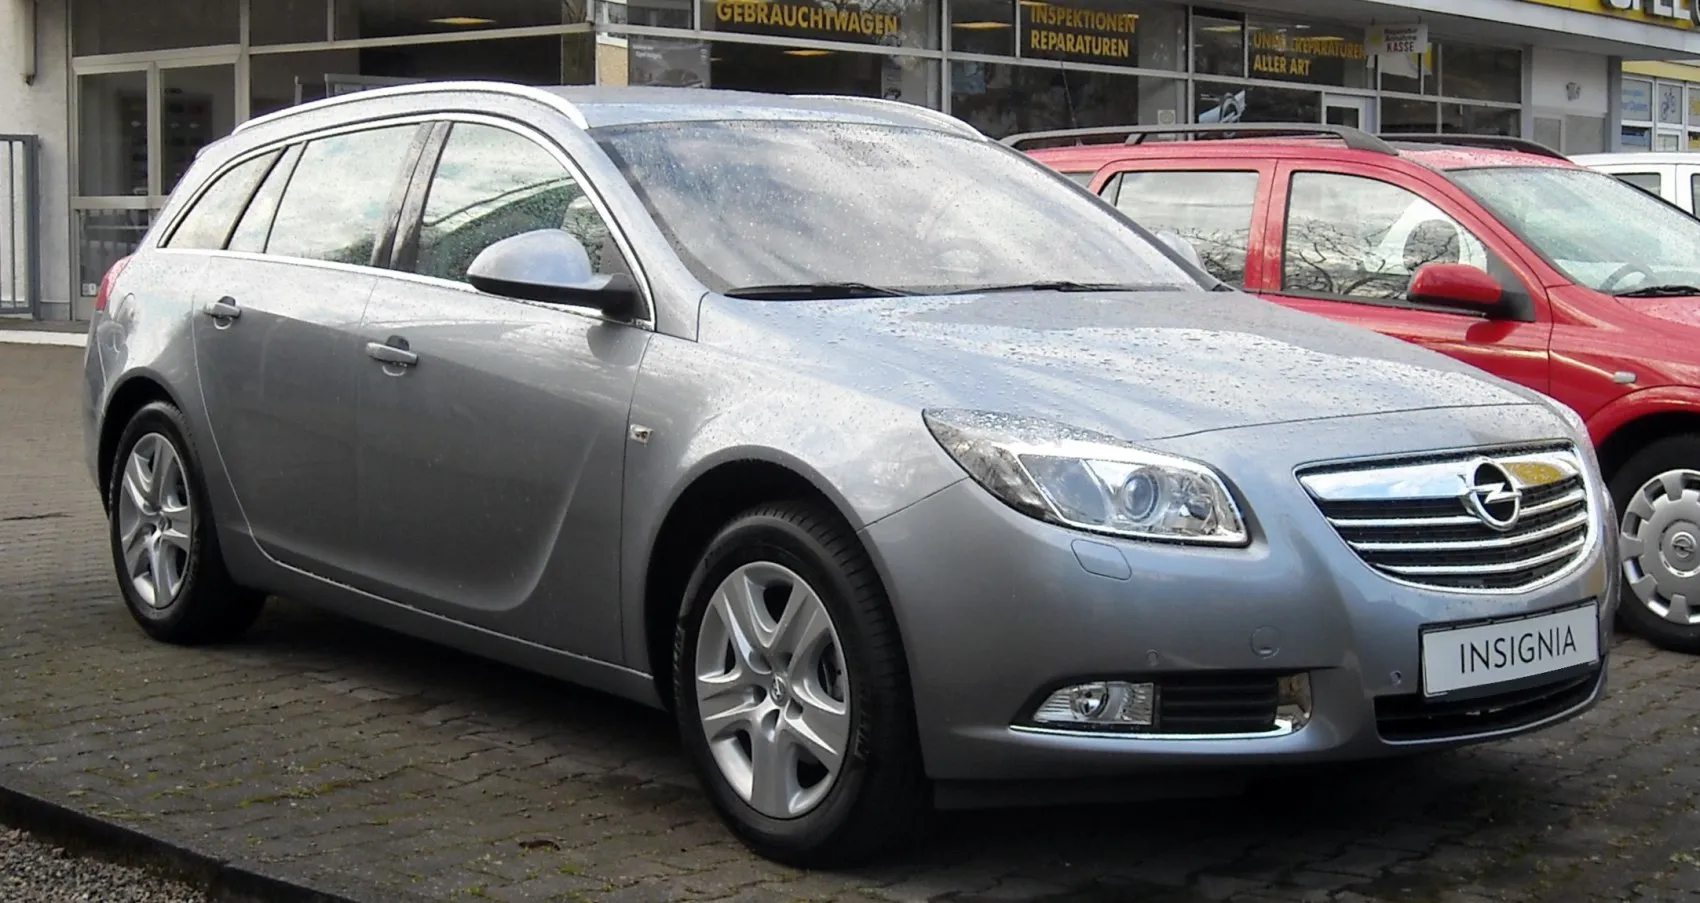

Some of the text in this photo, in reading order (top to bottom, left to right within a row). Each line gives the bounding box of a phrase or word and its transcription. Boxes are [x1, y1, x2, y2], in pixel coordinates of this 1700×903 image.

[716, 1, 898, 35] GEBRAUCHTWAGEN
[1031, 5, 1137, 33] INSPEKTIONEN
[1031, 29, 1130, 57] REPARATUREN
[1386, 41, 1415, 52] KASSE
[1253, 54, 1311, 76] ALLER ART
[1459, 624, 1577, 674] INSIGNIA
